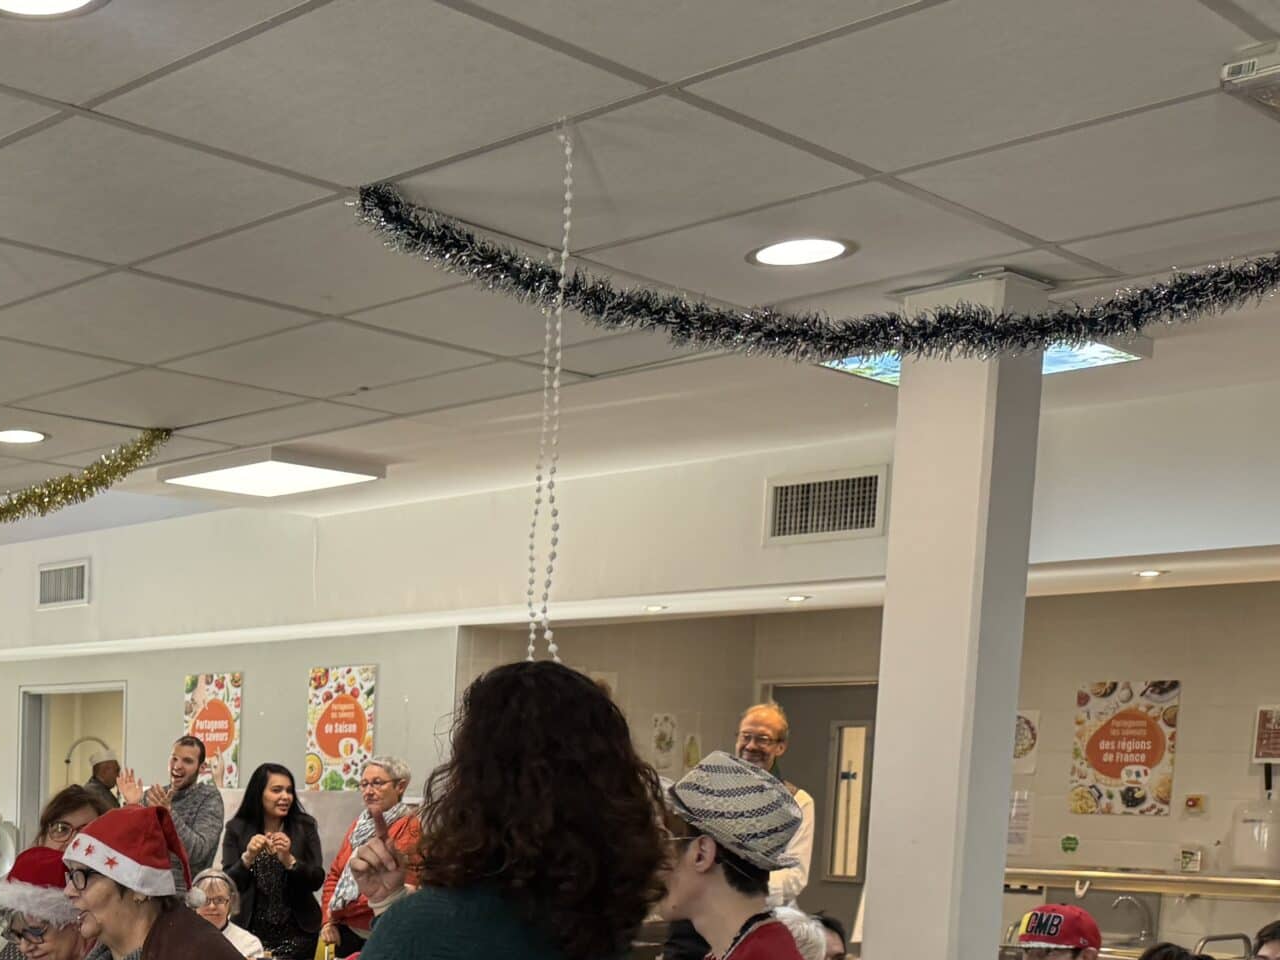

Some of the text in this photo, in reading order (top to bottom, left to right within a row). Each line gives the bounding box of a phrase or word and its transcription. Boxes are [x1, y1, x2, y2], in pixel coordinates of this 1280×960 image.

[334, 722, 357, 734] Saison
[1099, 737, 1152, 752] des régions
[1103, 751, 1146, 763] de France
